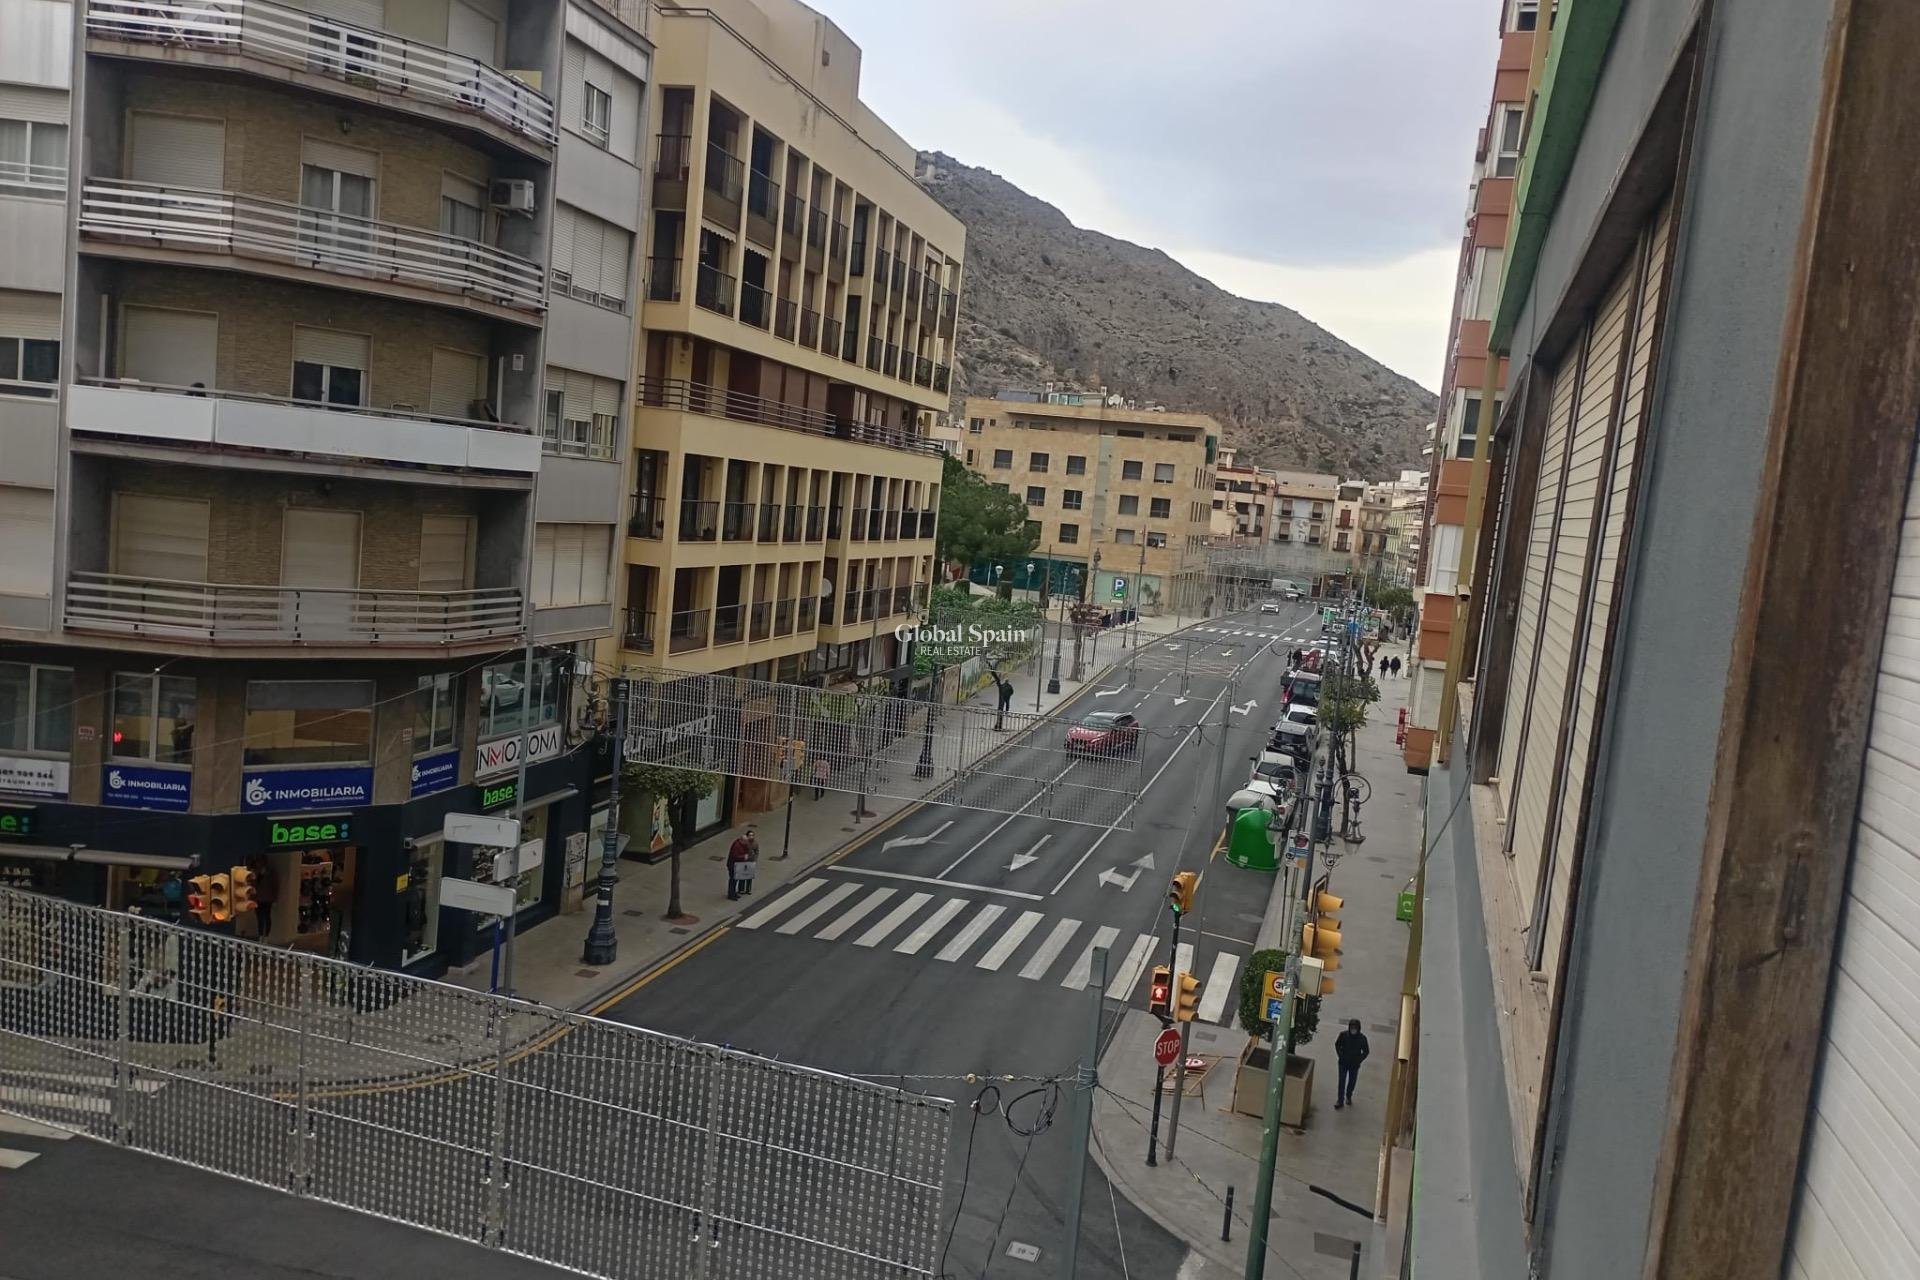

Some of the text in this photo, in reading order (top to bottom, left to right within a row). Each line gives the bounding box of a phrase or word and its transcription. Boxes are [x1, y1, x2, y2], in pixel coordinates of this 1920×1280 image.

[127, 779, 187, 792] INMOBILIARIA
[275, 785, 365, 800] INMOBILIARIA
[1156, 1039, 1180, 1056] STOP
